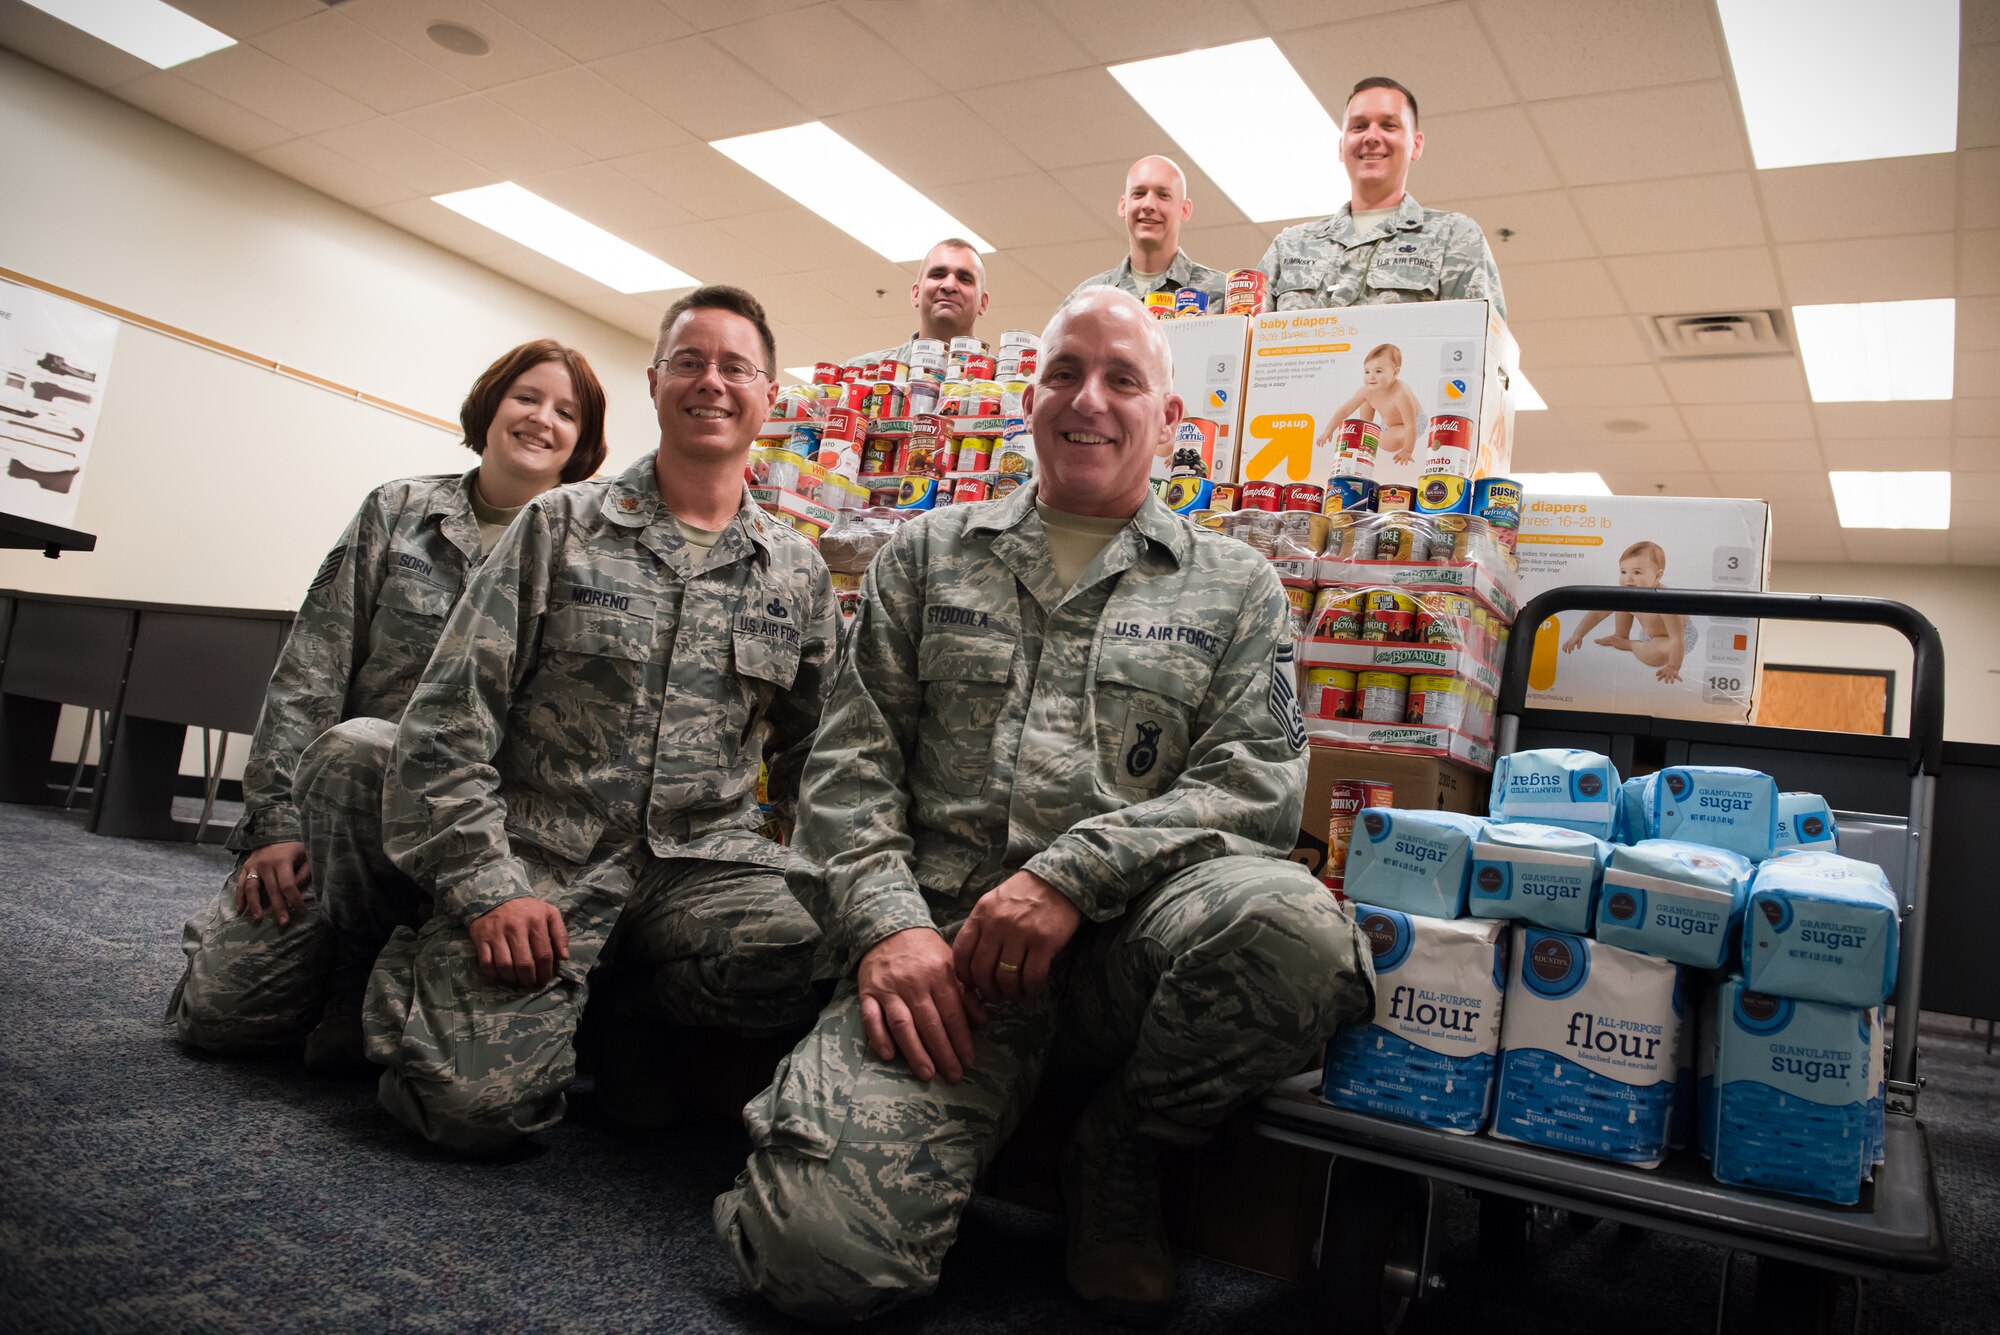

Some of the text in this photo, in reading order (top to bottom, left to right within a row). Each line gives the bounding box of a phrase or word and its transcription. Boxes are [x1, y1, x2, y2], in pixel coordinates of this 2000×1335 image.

[1409, 258, 1435, 269] FORCE
[1228, 281, 1254, 290] CHUNKY
[1156, 294, 1173, 304] WIN
[1260, 316, 1338, 330] baby diapers
[1259, 332, 1279, 342] size
[1348, 326, 1358, 336] lb
[1453, 350, 1463, 361] 3
[1217, 362, 1226, 373] 3
[1271, 419, 1309, 430] up&up
[762, 440, 777, 448] WIN
[812, 465, 825, 479] WIN
[1242, 485, 1277, 499] Campbell's
[1490, 486, 1519, 502] BUSH'S
[1483, 506, 1506, 516] Refried
[1531, 501, 1587, 515] diapers
[1600, 516, 1612, 529] lb
[1564, 537, 1600, 545] protection
[1727, 557, 1739, 569] 3
[1408, 569, 1464, 585] BOYARDEE
[572, 586, 629, 611] MORENO
[739, 618, 758, 633] U.S.
[760, 620, 779, 637] AIR
[1114, 622, 1221, 652] U.S. AIR FORCE
[1391, 650, 1447, 666] BOYARDEE
[1708, 676, 1741, 692] 180
[1384, 729, 1438, 747] BOYARDEE
[1510, 772, 1561, 786] sugar
[1510, 786, 1562, 794] GRANULATED
[1699, 788, 1753, 799] GRANULATED
[1699, 796, 1753, 813] sugar
[1395, 832, 1449, 850] GRANULATED
[1394, 841, 1447, 863] sugar
[1383, 857, 1391, 865] NET
[1521, 873, 1582, 885] GRANULATED
[1522, 882, 1581, 901] sugar
[1655, 903, 1720, 922] GRANULATED
[1655, 913, 1719, 936] sugar
[1799, 919, 1867, 935] GRANULATED
[1366, 930, 1394, 942] OUNDY'S
[1800, 929, 1866, 950] sugar
[1533, 954, 1568, 966] ROUNDY'S
[1789, 949, 1799, 957] NET
[1418, 990, 1482, 1009] ALL-PURPOSE
[1388, 985, 1480, 1032] flour
[1399, 1023, 1477, 1044] bleached and enriched
[1597, 1016, 1663, 1036] ALL-PURPOSE
[1566, 1011, 1661, 1061] flour
[1769, 1043, 1851, 1061] GRANULATED
[1433, 1057, 1454, 1072] rich
[1512, 1057, 1541, 1071] yummy
[1577, 1050, 1658, 1072] bleached and enriched
[1771, 1056, 1851, 1083] sugar
[1375, 1079, 1413, 1094] DELICIOUS
[1542, 1075, 1567, 1088] divine
[1349, 1083, 1379, 1096] YUMMY
[1615, 1085, 1637, 1101] rich
[1525, 1112, 1558, 1126] YUMMY
[1554, 1109, 1594, 1124] DELICIOUS
